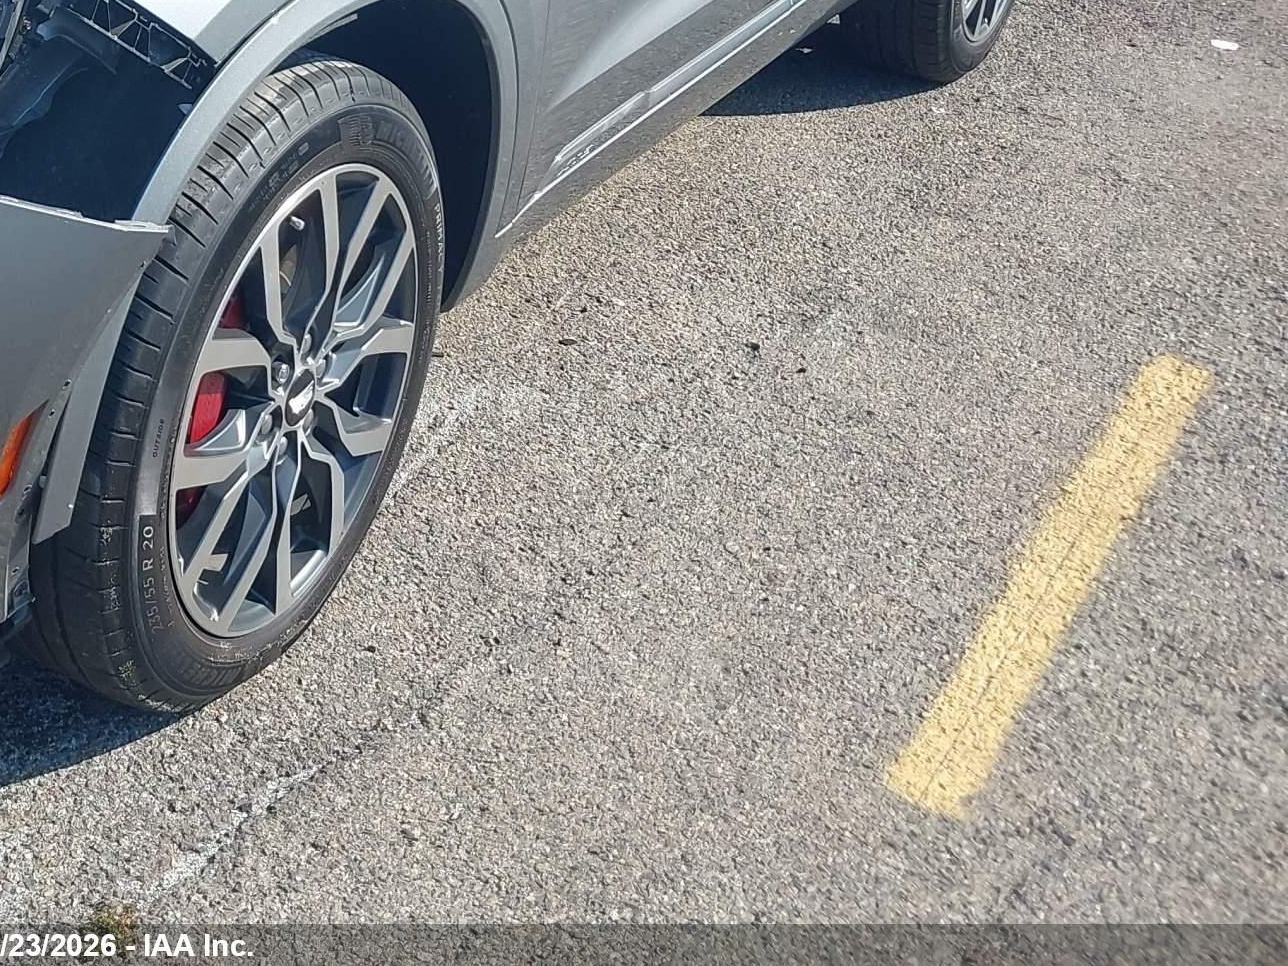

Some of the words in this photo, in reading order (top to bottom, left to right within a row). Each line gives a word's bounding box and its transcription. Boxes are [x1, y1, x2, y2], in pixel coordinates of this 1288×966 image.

[151, 418, 165, 459] OUTSIDE
[141, 524, 155, 550] 20
[141, 557, 154, 571] R
